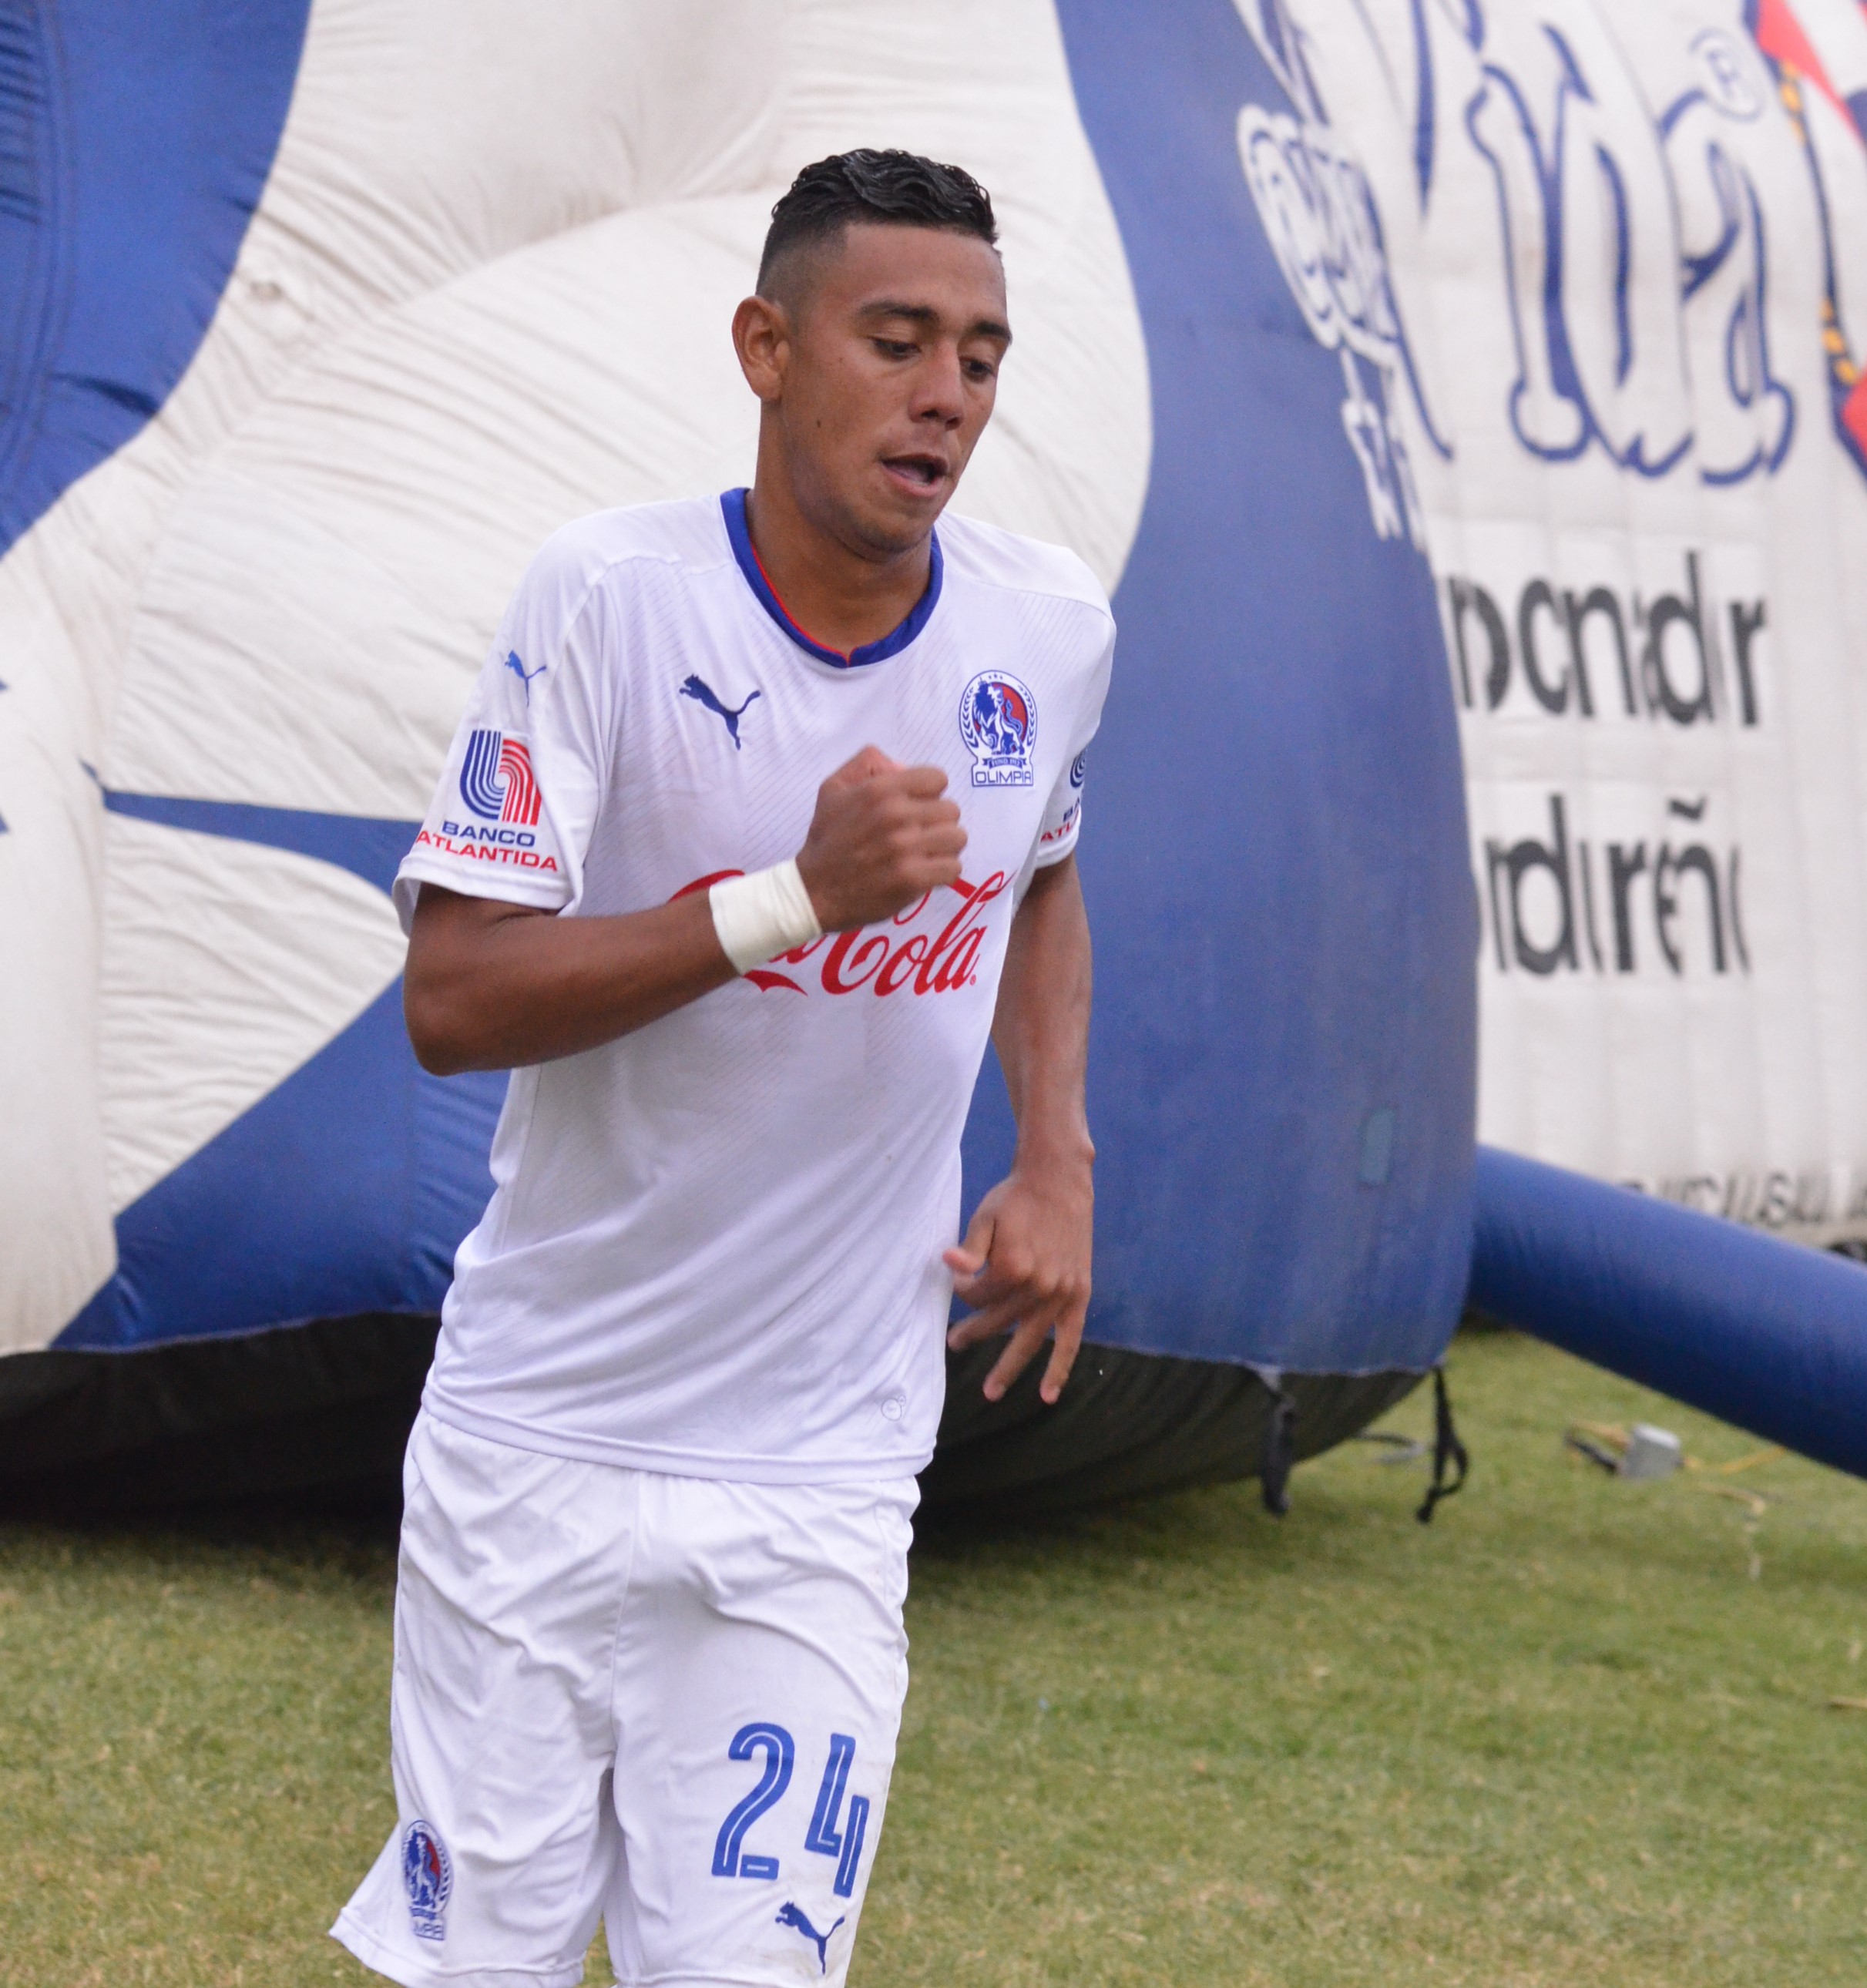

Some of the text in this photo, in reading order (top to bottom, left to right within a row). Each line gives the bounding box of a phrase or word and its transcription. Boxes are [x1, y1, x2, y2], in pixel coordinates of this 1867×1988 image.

[975, 771, 1031, 783] OLIMPIA
[442, 821, 535, 846] BANCO
[416, 831, 557, 871] ATLANTIDA
[710, 1722, 870, 1898] 24
